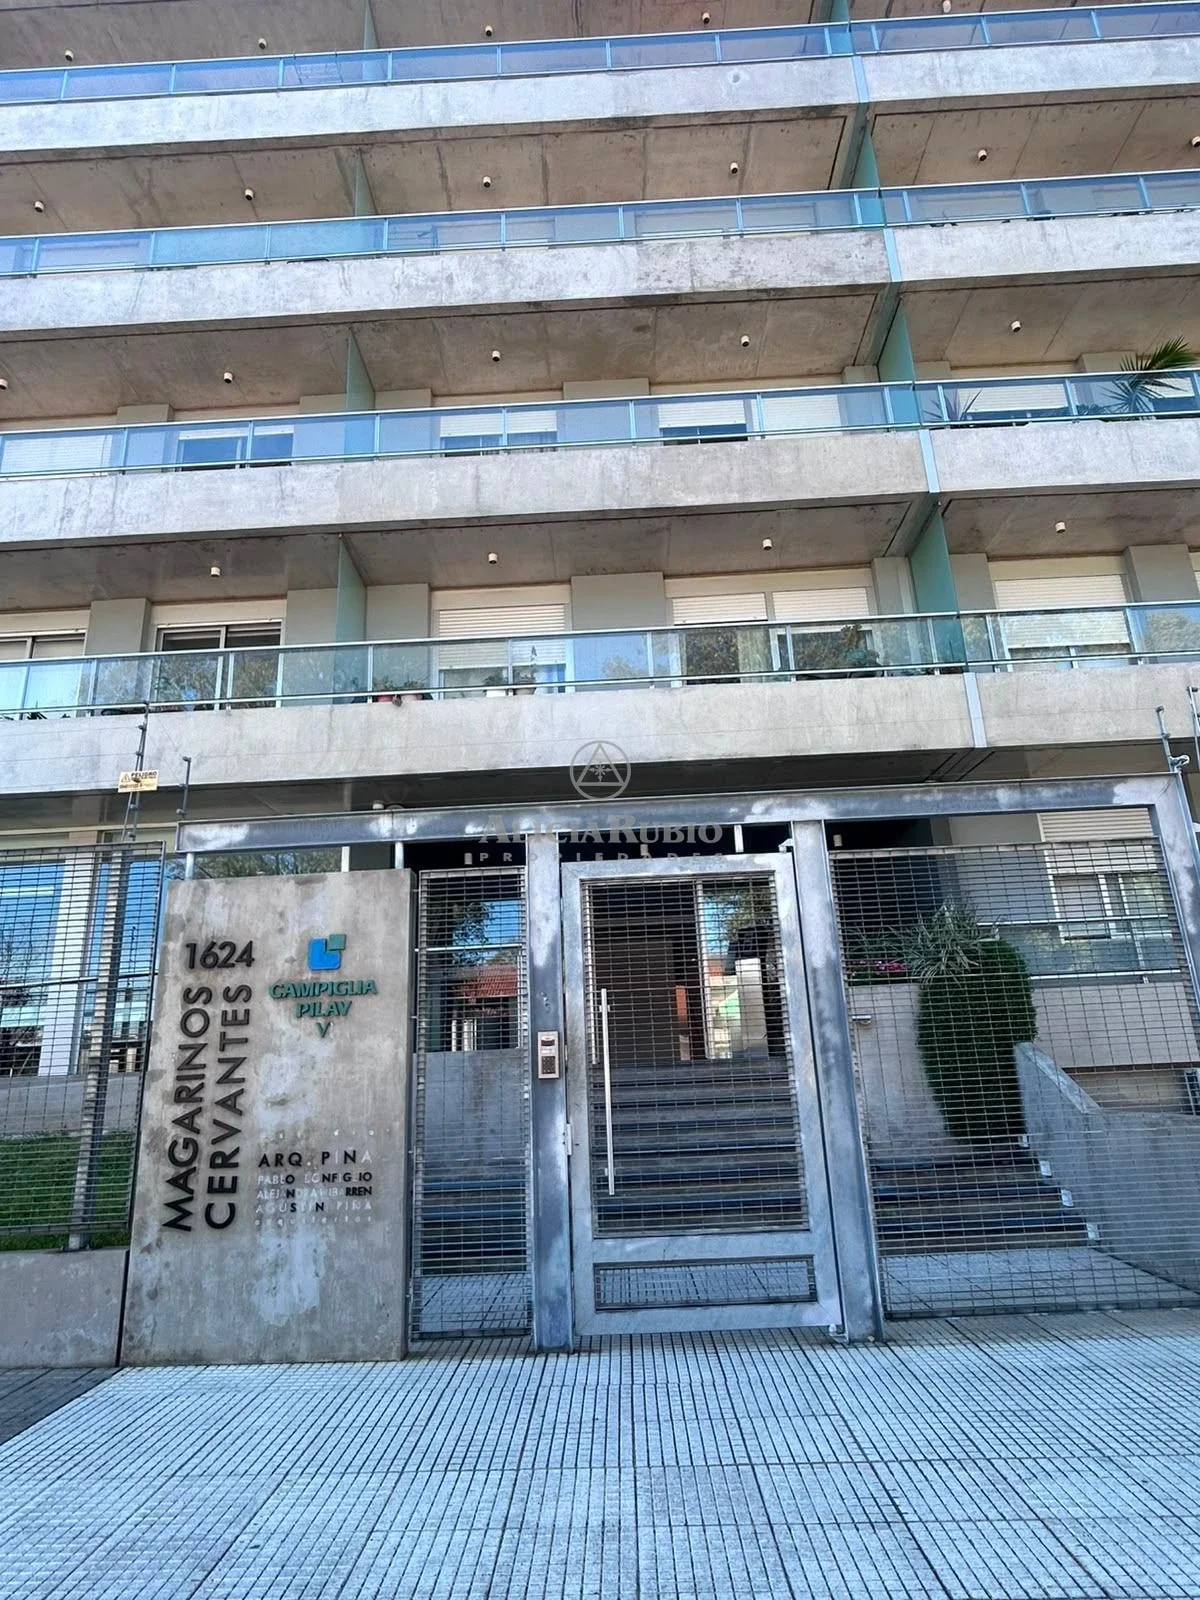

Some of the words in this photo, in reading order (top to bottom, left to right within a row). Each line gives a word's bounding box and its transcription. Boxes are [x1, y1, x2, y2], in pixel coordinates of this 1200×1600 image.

[185, 940, 255, 970] 1624
[269, 979, 378, 999] CAMPIGLIA
[315, 1022, 332, 1038] V
[162, 986, 212, 1232] MAGARINOS
[204, 983, 253, 1230] CERVANTES
